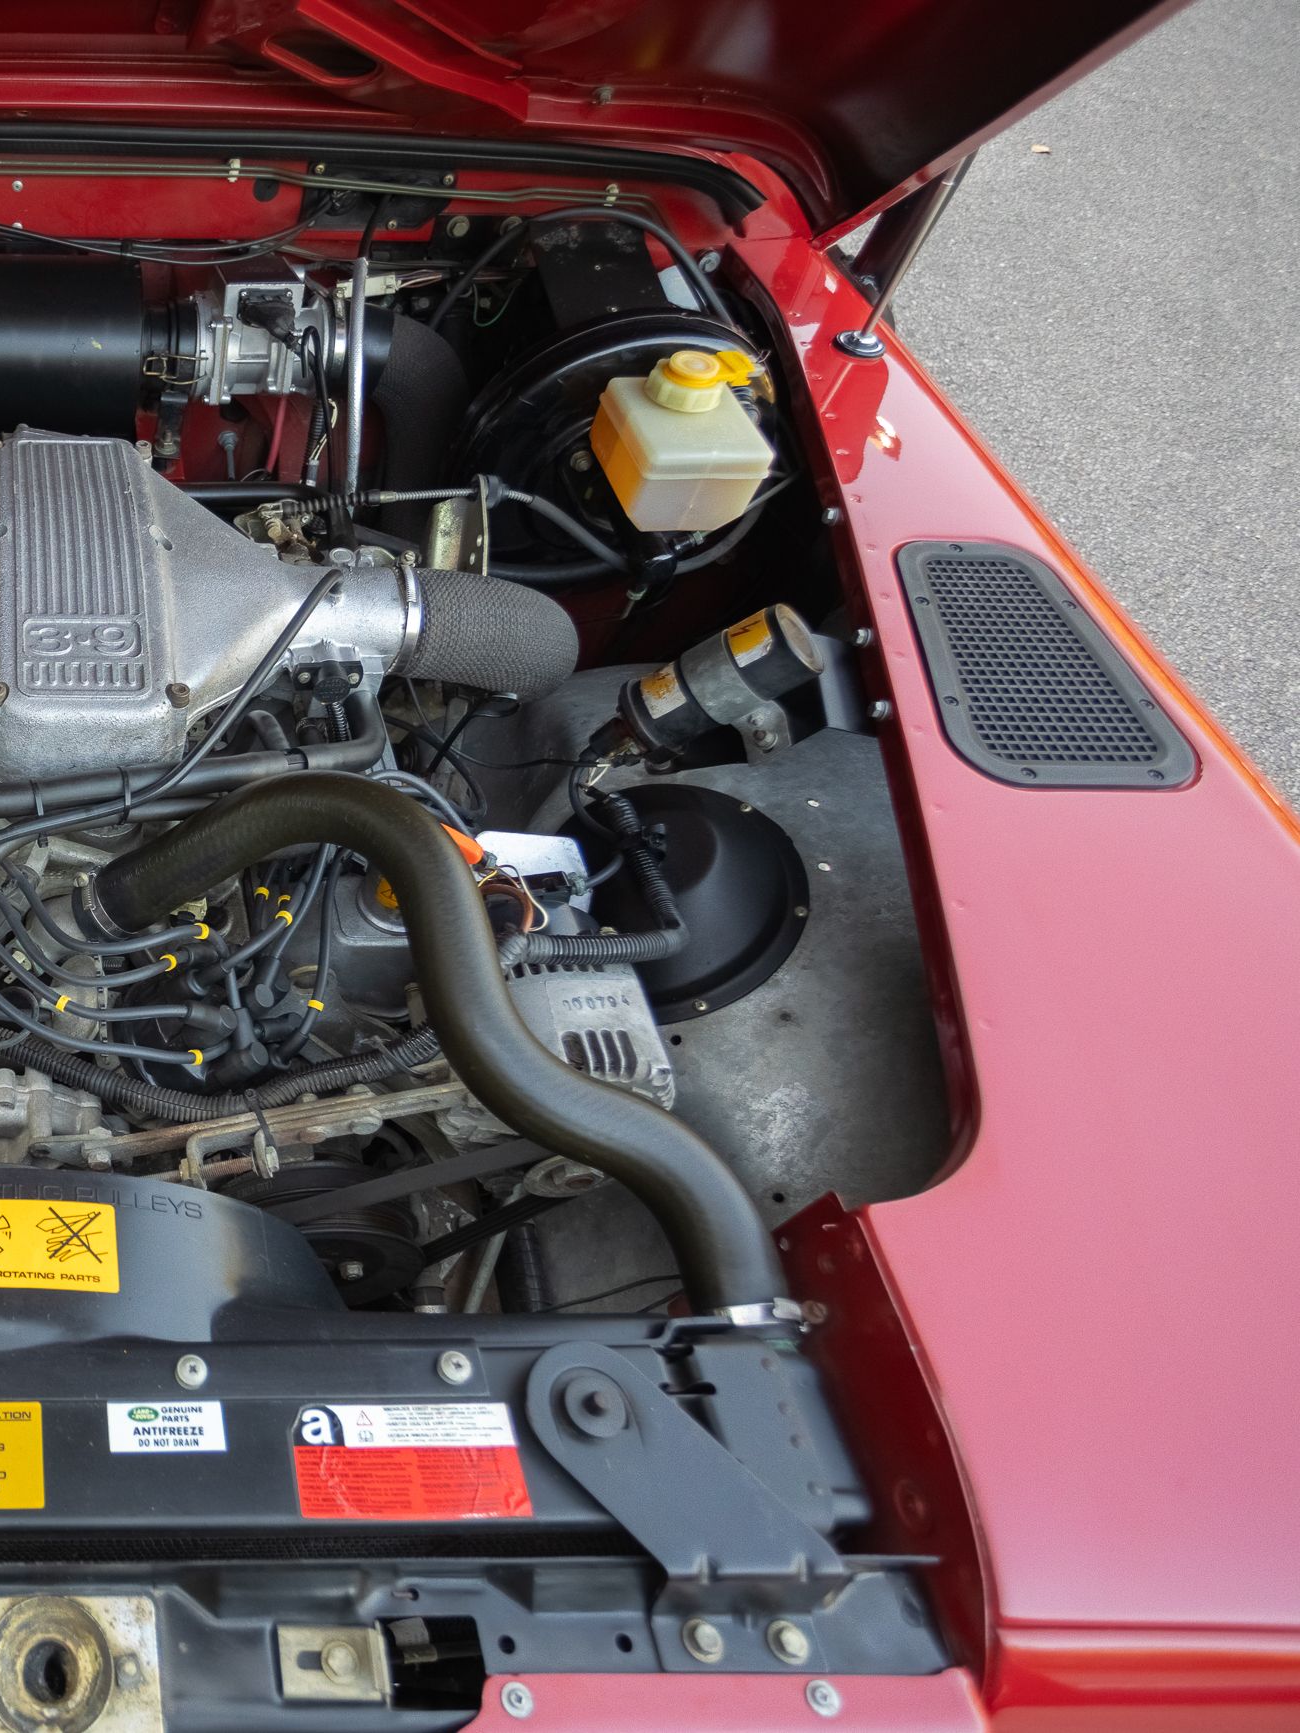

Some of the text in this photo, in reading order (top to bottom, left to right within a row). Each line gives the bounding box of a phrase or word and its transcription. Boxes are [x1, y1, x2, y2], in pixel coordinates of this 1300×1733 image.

[76, 1185, 203, 1220] PULLEYS
[61, 1273, 101, 1283] PARTS
[161, 1406, 203, 1414] GENUINE
[162, 1415, 190, 1423] PARTS
[133, 1426, 204, 1436] ANTIFREEZE
[138, 1438, 200, 1447] DO NOT DRAIN
